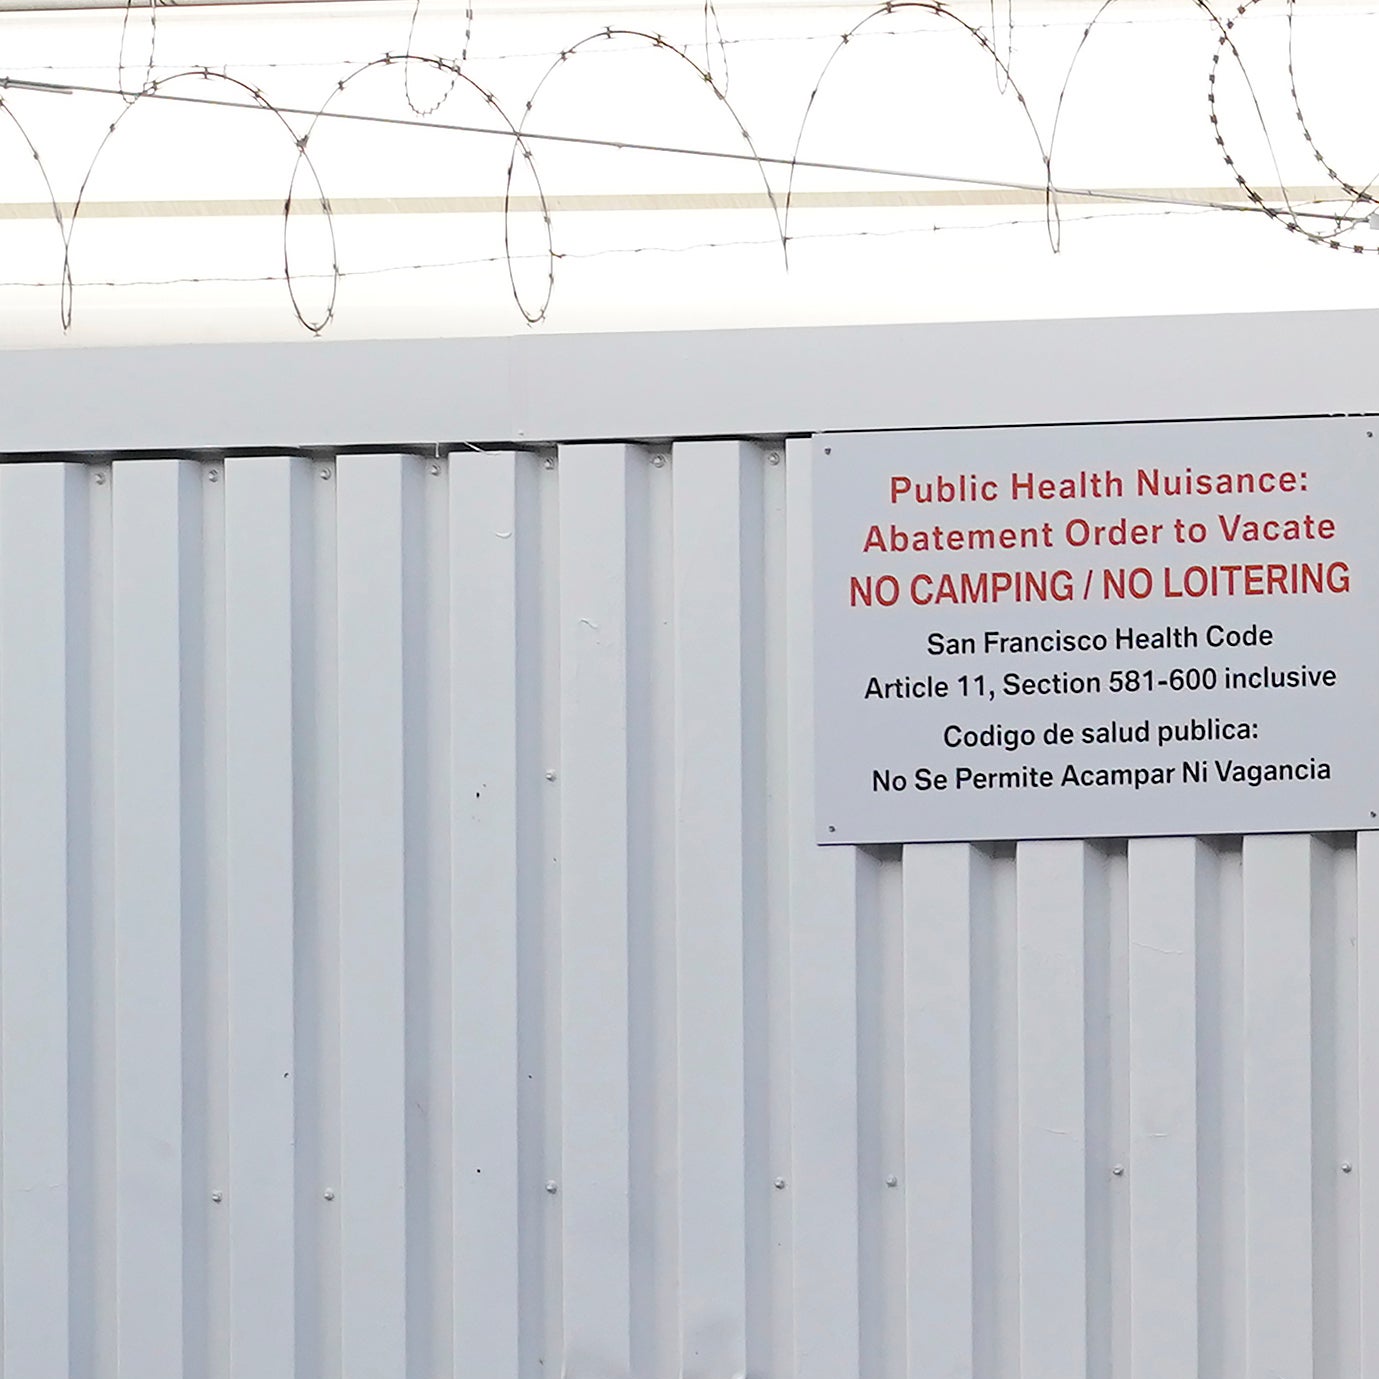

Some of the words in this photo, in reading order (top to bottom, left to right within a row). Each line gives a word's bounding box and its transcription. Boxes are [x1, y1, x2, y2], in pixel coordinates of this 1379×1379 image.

[892, 475, 997, 503] Public
[1012, 471, 1122, 500] Health
[1138, 468, 1306, 496] Nuisance:
[863, 523, 1053, 552] Abatement
[1066, 518, 1163, 546] Order
[1174, 519, 1206, 543] to
[1219, 515, 1335, 541] Vacate
[851, 575, 899, 606] NO
[911, 570, 1073, 605] CAMPING
[1084, 570, 1093, 600] /
[1104, 568, 1152, 599] NO
[1165, 562, 1349, 597] LOITERING
[928, 633, 975, 655] San
[985, 630, 1107, 653] Francisco
[1116, 626, 1197, 649] Health
[1207, 624, 1273, 647] Code
[865, 676, 948, 699] Article
[958, 675, 994, 701] 11,
[1003, 672, 1100, 695] Section
[1109, 668, 1216, 692] 581-600
[1226, 665, 1336, 688] inclusive
[944, 724, 1035, 751] Codigo
[1044, 723, 1073, 745] de
[1082, 720, 1149, 743] salud
[1158, 718, 1257, 747] publica:
[873, 770, 906, 791] No
[915, 768, 947, 790] Se
[956, 766, 1053, 789] Permite
[1061, 765, 1175, 789] Acampar
[1183, 761, 1207, 783] Ni
[1215, 758, 1330, 786] Vagancia
